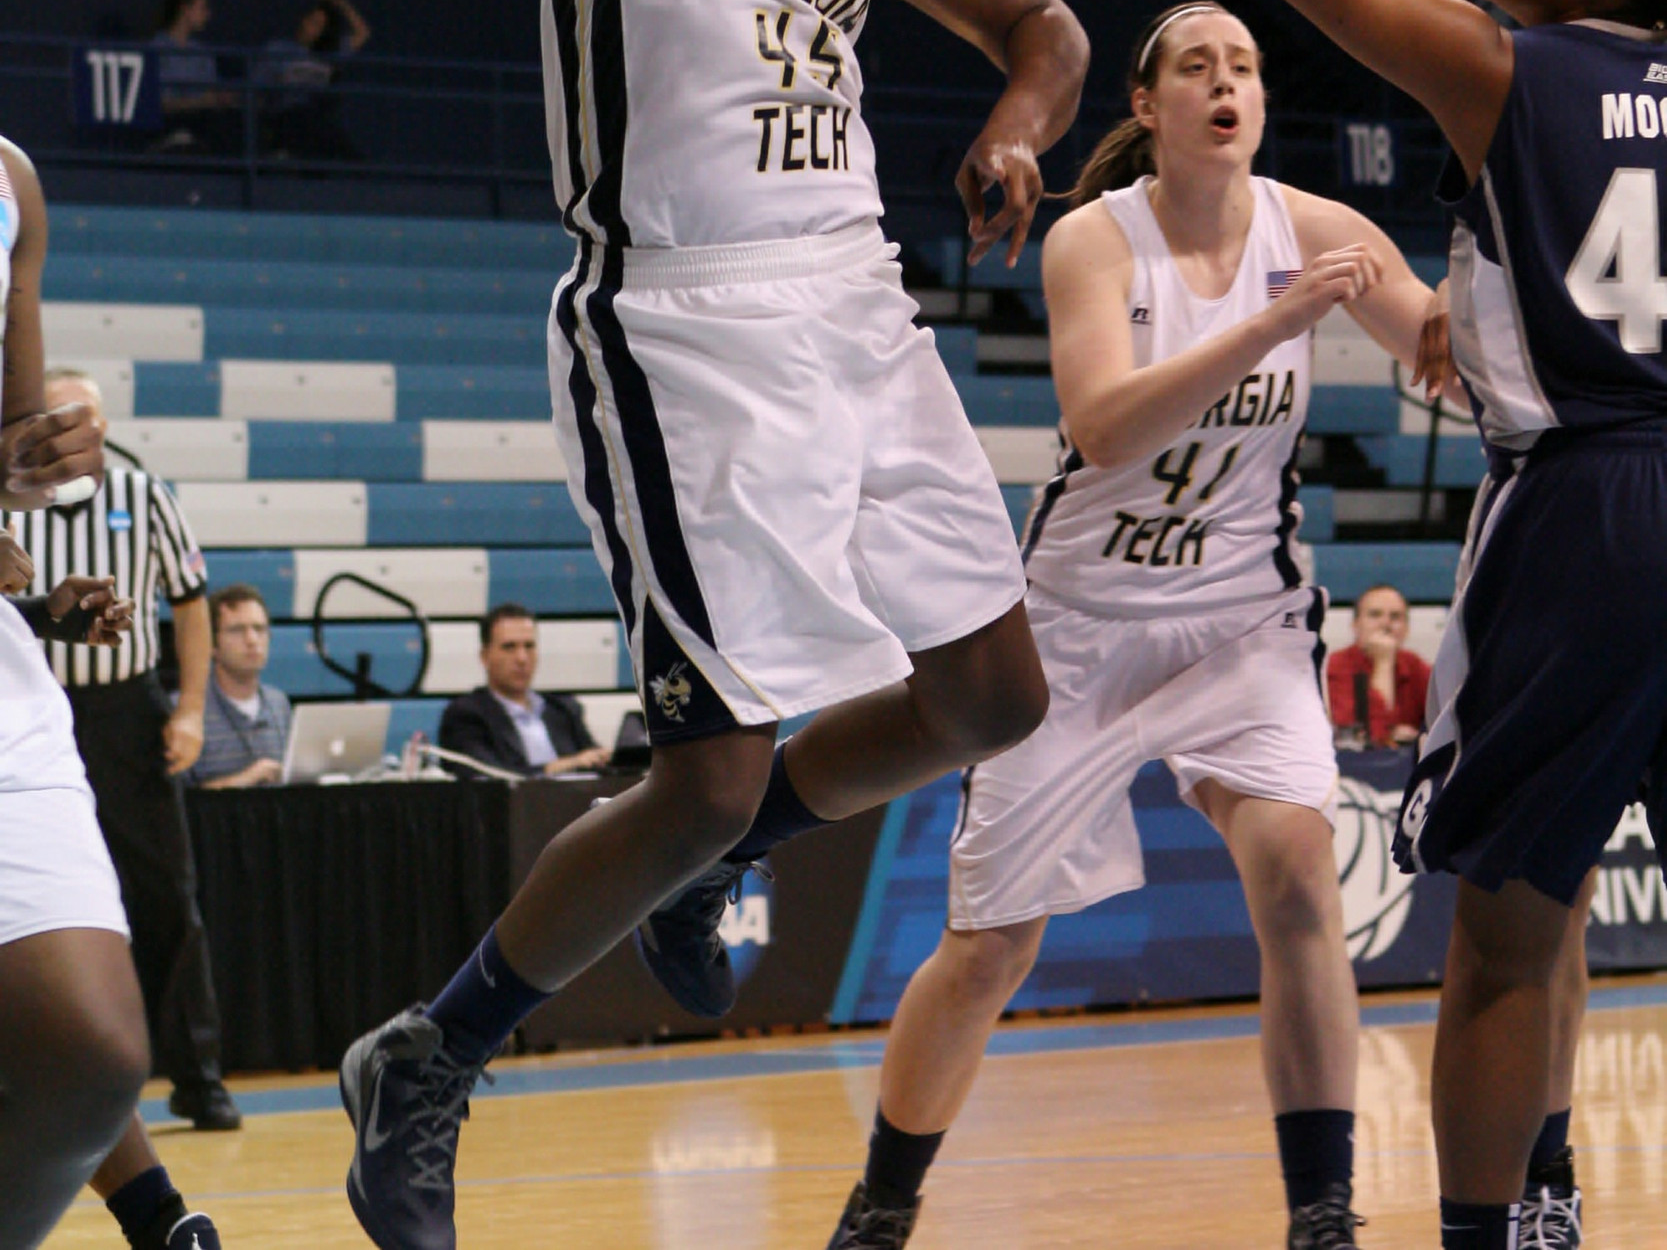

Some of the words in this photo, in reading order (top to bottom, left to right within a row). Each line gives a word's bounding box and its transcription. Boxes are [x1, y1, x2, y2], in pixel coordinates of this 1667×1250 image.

[86, 51, 144, 123] 117
[753, 103, 852, 173] TECH
[1346, 124, 1394, 187] 118
[1564, 166, 1667, 354] 4
[1152, 441, 1239, 506] 41
[1101, 511, 1213, 566] TECH
